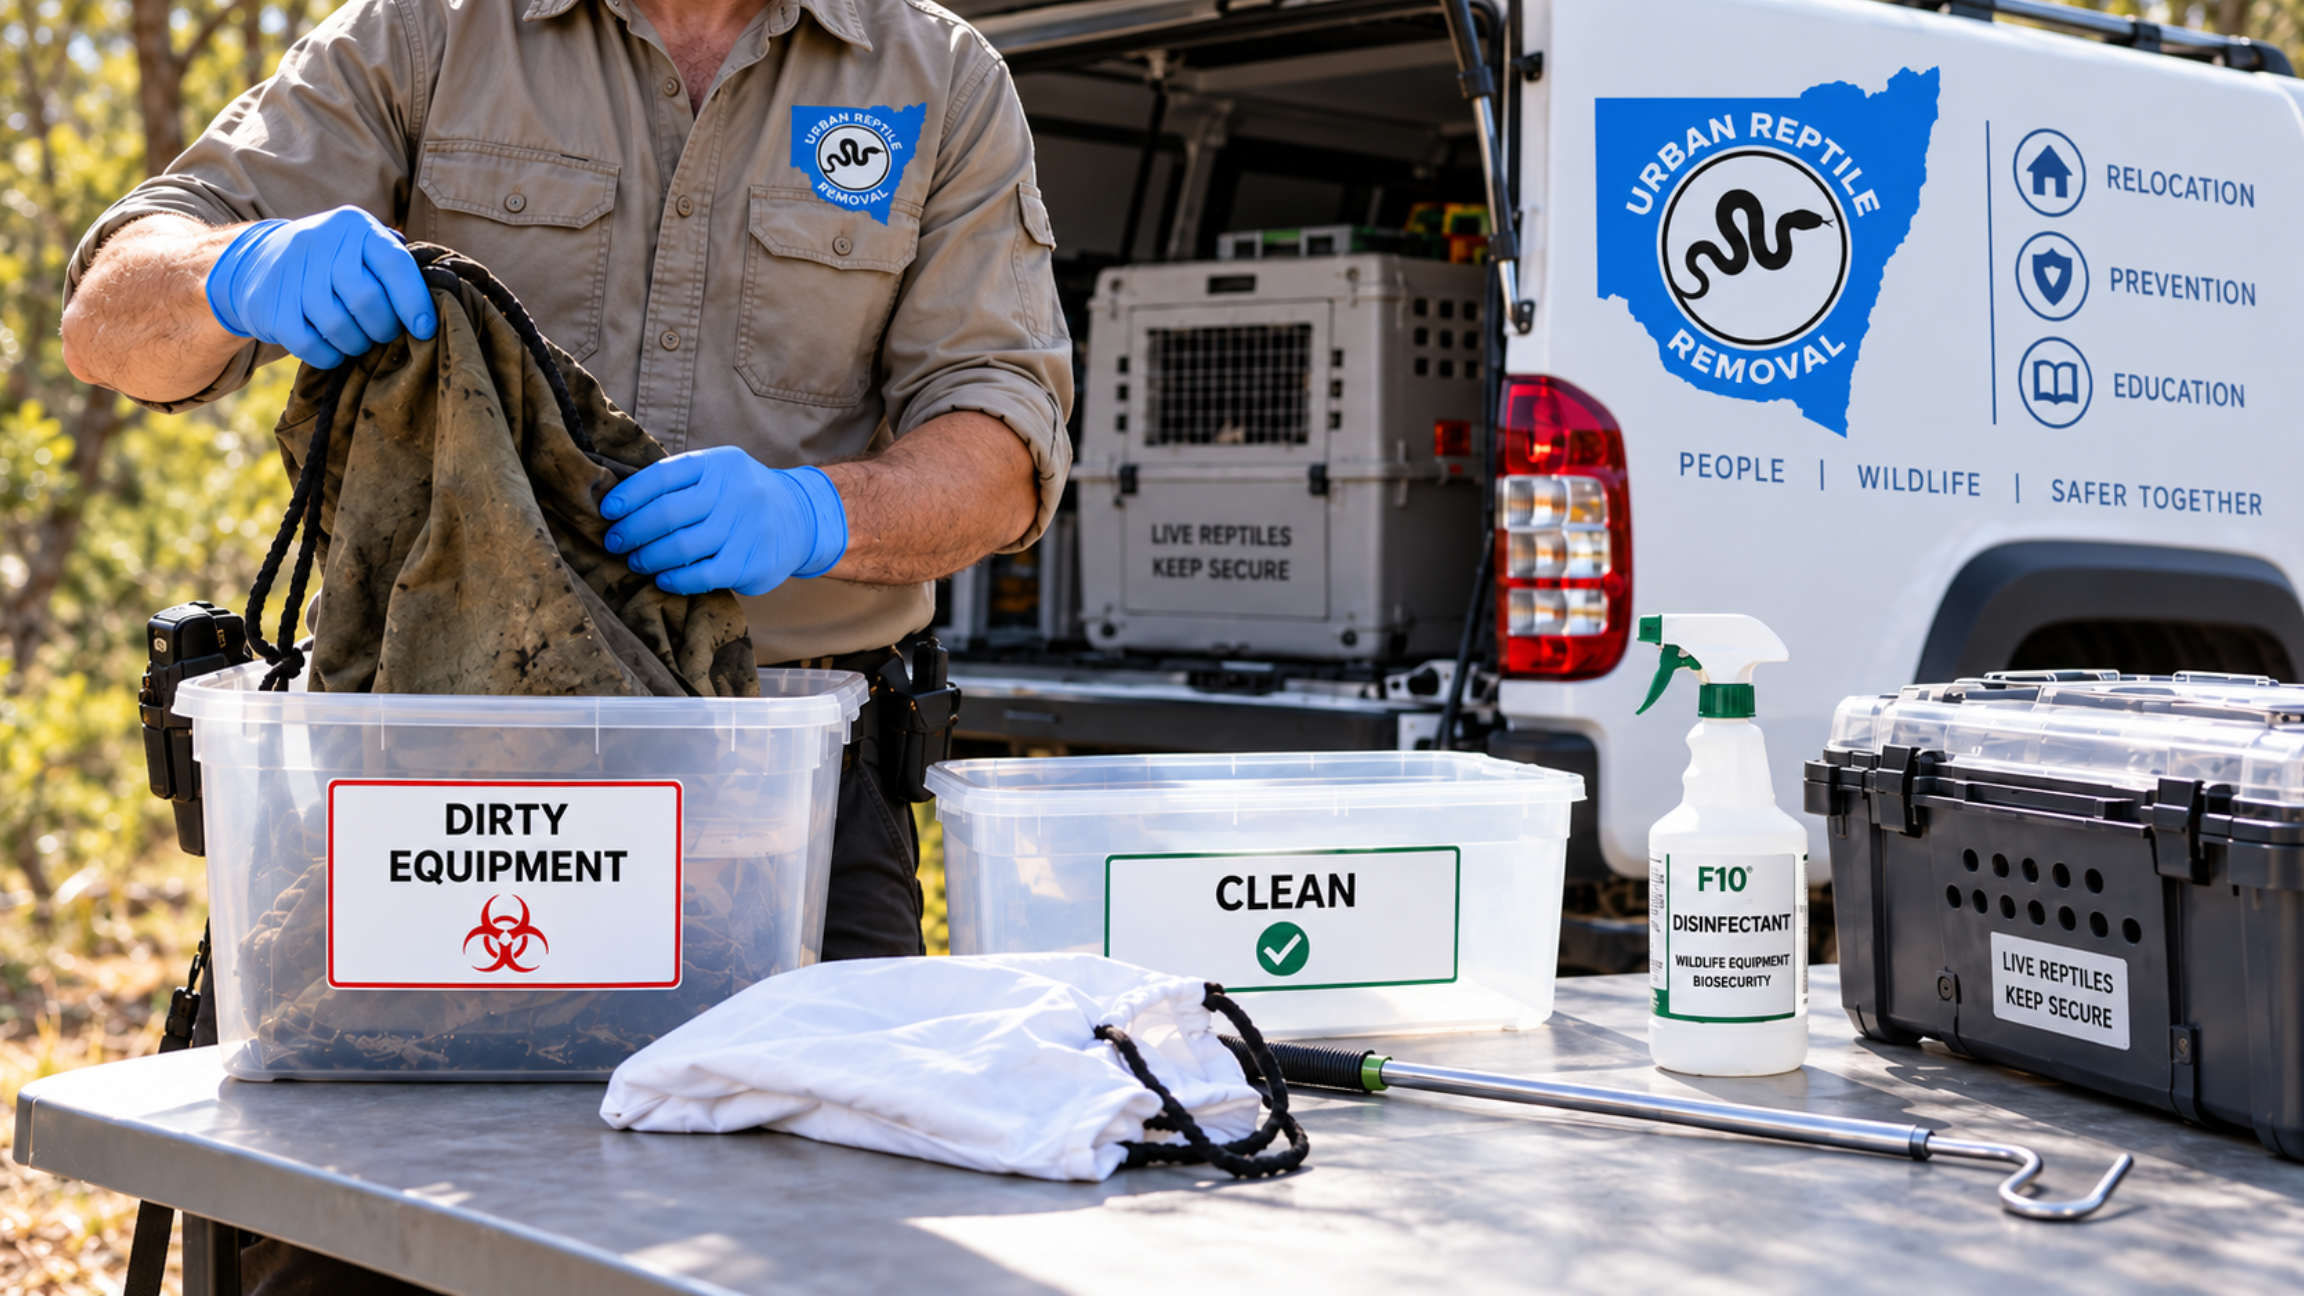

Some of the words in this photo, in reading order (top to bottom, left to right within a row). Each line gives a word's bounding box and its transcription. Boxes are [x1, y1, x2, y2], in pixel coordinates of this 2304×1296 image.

[804, 112, 849, 145] URBAN
[854, 113, 903, 150] REPTILE
[1625, 113, 1737, 216] URBAN
[1750, 111, 1881, 218] REPTILE
[817, 181, 889, 206] REMOVAL
[2106, 164, 2256, 209] RELOCATION
[2110, 267, 2257, 307] PREVENTION
[1666, 328, 1847, 386] REMOVAL
[2113, 373, 2246, 409] EDUCATION
[1679, 452, 1785, 484] PEOPLE
[1857, 465, 1981, 497] WILDLIFE
[2051, 479, 2127, 507] SAFER
[2140, 486, 2263, 517] TOGETHER
[1151, 524, 1194, 545] LIVE
[1200, 525, 1292, 547] REPTILES
[1152, 558, 1202, 578] KEEP
[1209, 559, 1290, 581] SECURE
[445, 803, 569, 836] DIRTY
[390, 850, 628, 885] EQUIPMENT
[1216, 873, 1356, 911] CLEAN
[1672, 913, 1791, 933] DISINFECTANT
[1675, 954, 1726, 969] WILDLIFE
[1729, 953, 1790, 970] EQUIPMENT
[2002, 951, 2035, 977] LIVE
[2040, 960, 2114, 994] REPTILES
[1693, 975, 1771, 988] BIOSECURITY
[2005, 985, 2043, 1011] KEEP
[2048, 996, 2113, 1029] SECURE
